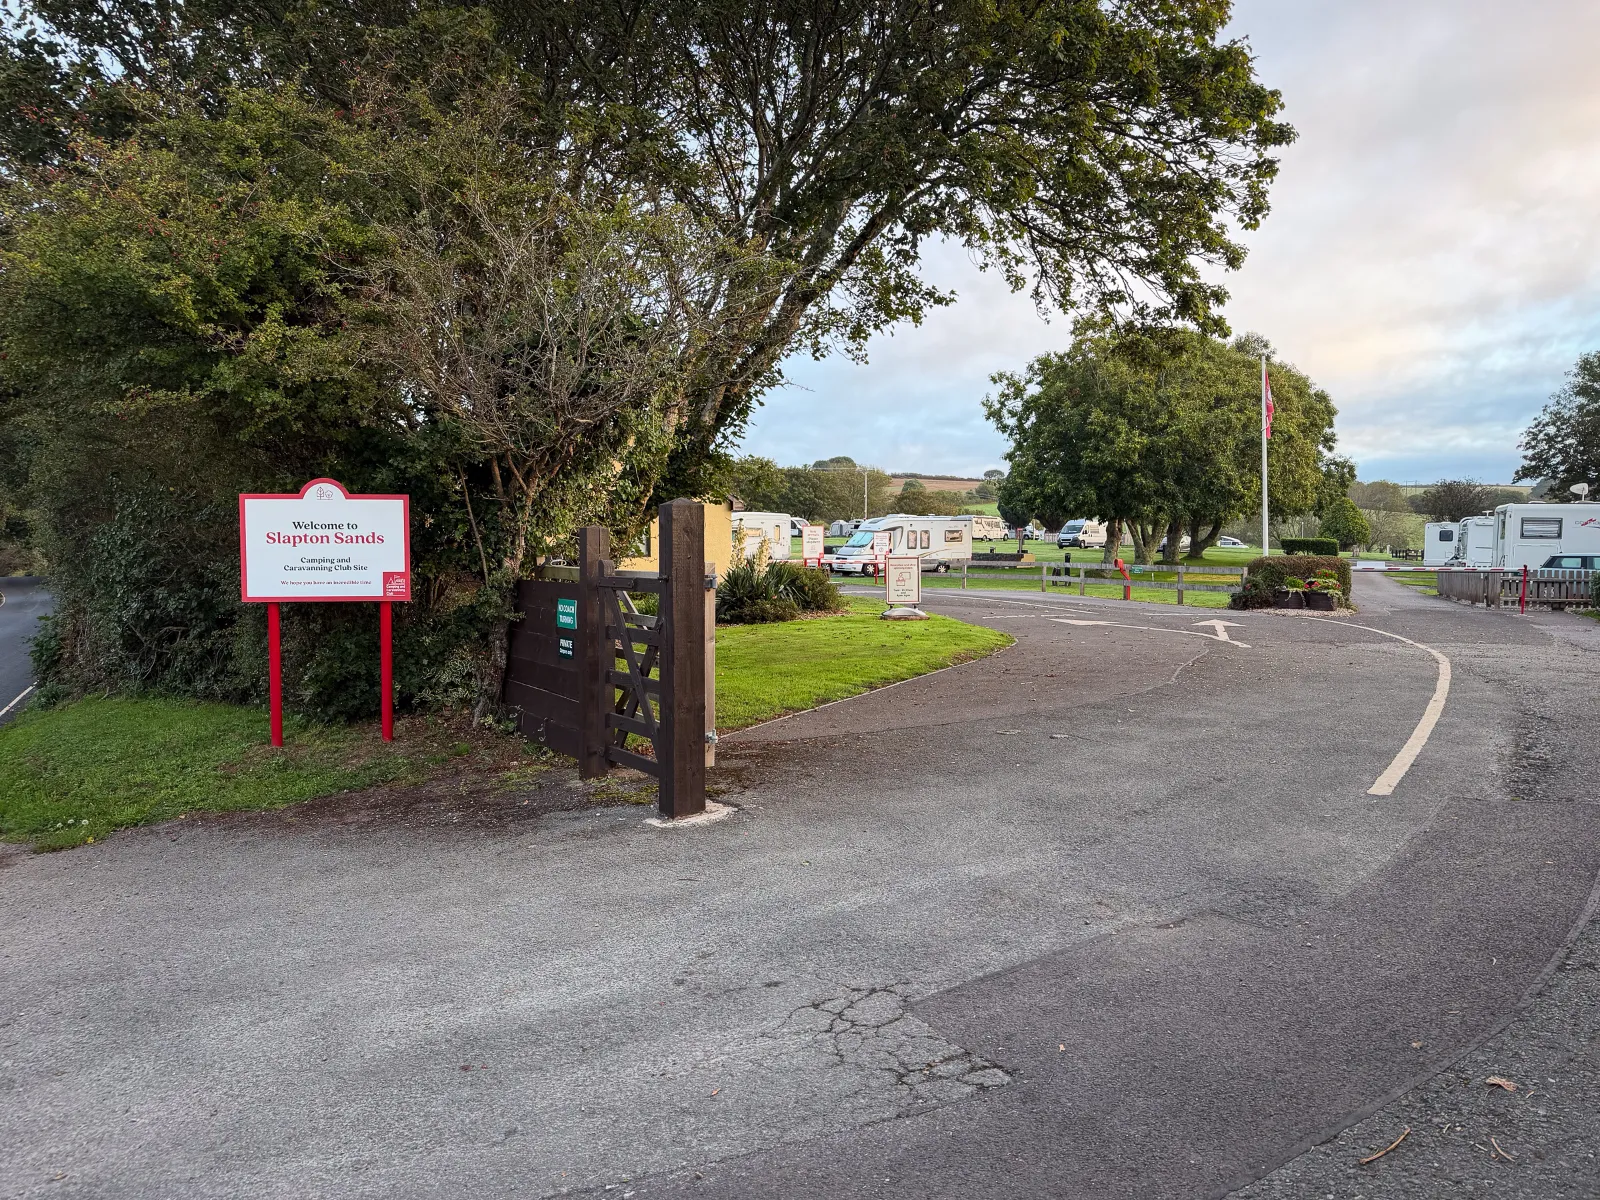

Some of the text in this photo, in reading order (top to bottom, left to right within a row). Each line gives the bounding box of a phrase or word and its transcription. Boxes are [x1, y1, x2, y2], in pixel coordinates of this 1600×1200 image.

[292, 521, 358, 530] Welcome to
[266, 531, 385, 547] Slapton Sands
[300, 556, 351, 565] Camping and
[283, 564, 333, 572] Caravanning
